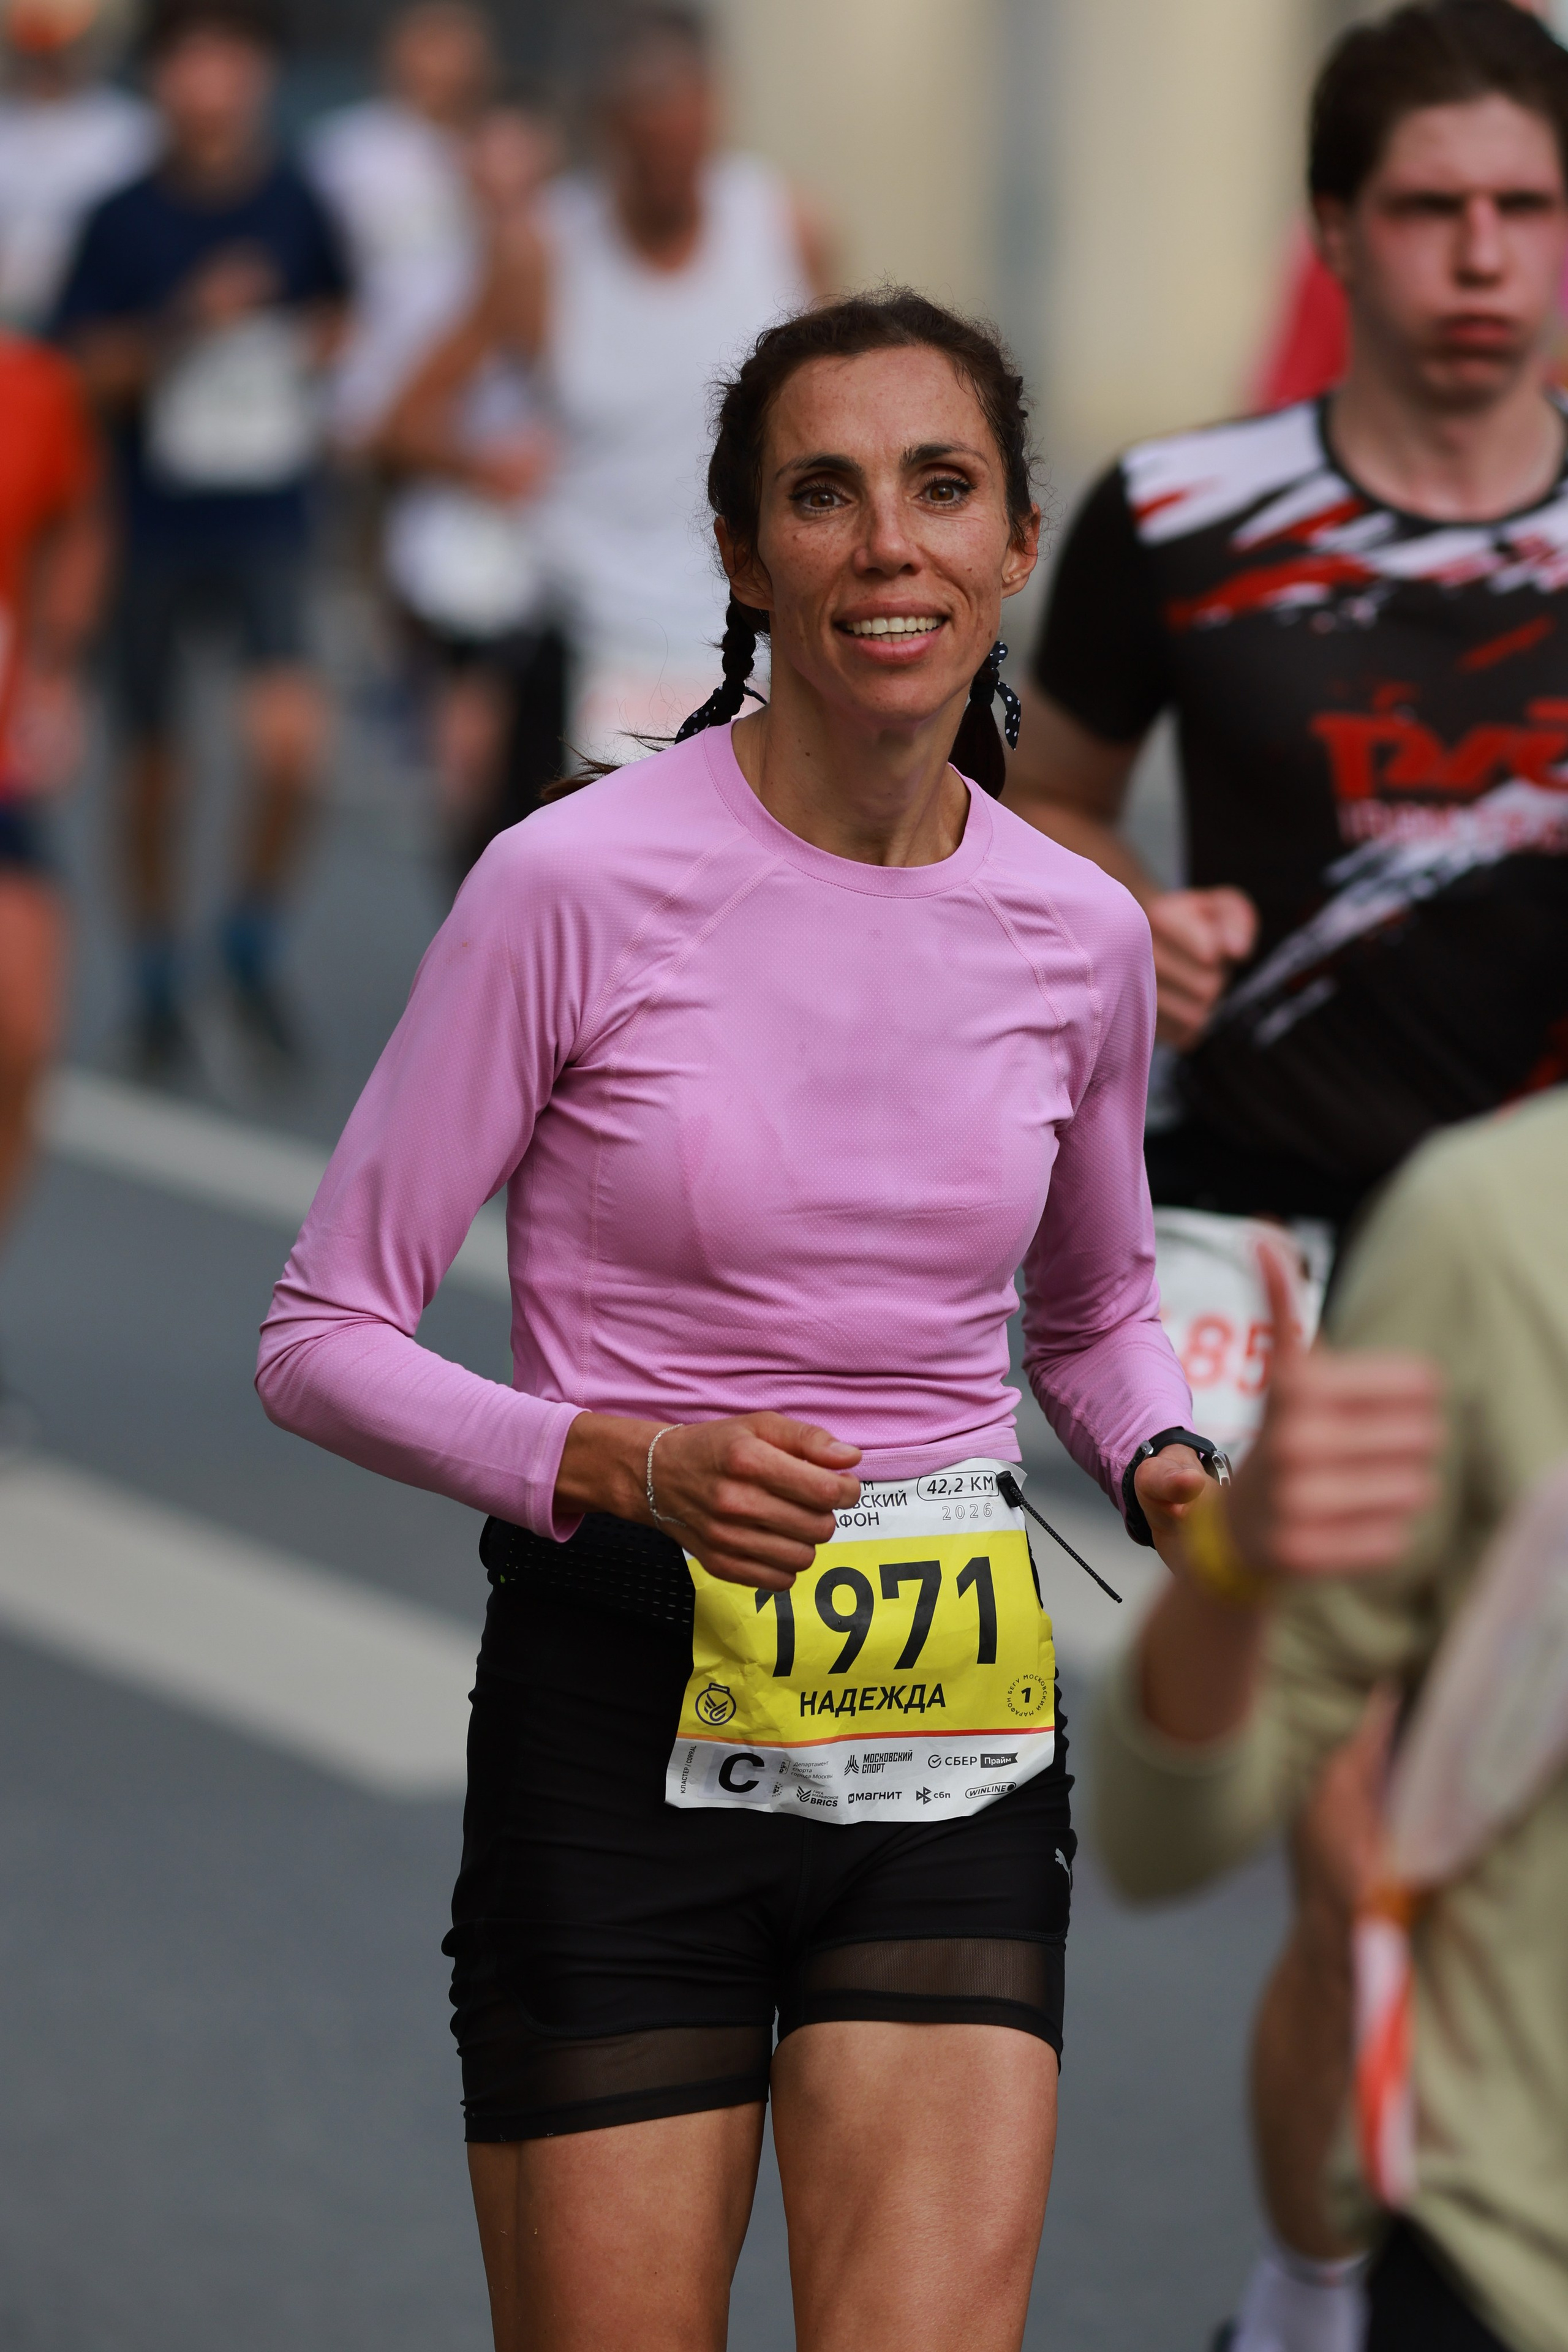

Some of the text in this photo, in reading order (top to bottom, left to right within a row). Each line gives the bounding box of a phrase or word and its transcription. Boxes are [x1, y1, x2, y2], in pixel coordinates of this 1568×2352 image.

[927, 1476, 994, 1496] 42,2 КМ
[834, 1490, 908, 1511] СКИЙ
[942, 1502, 992, 1520] 2026
[754, 1556, 998, 1678] 1971
[1008, 1678, 1020, 1694] БЕГУ
[800, 1683, 946, 1718] НАДЕЖДА
[1021, 1687, 1031, 1703] 1
[1006, 1697, 1034, 1717] МАРАФОН
[863, 1749, 913, 1763] МОСКОВСКИЙ
[944, 1756, 1011, 1766] СБЕР Прайм
[680, 1767, 690, 1794] КЛАСТЕР
[685, 1746, 697, 1763] CORRAL
[862, 1763, 886, 1774] СПОРТ
[969, 1784, 1006, 1797] WINLINE
[810, 1797, 839, 1807] BRICS
